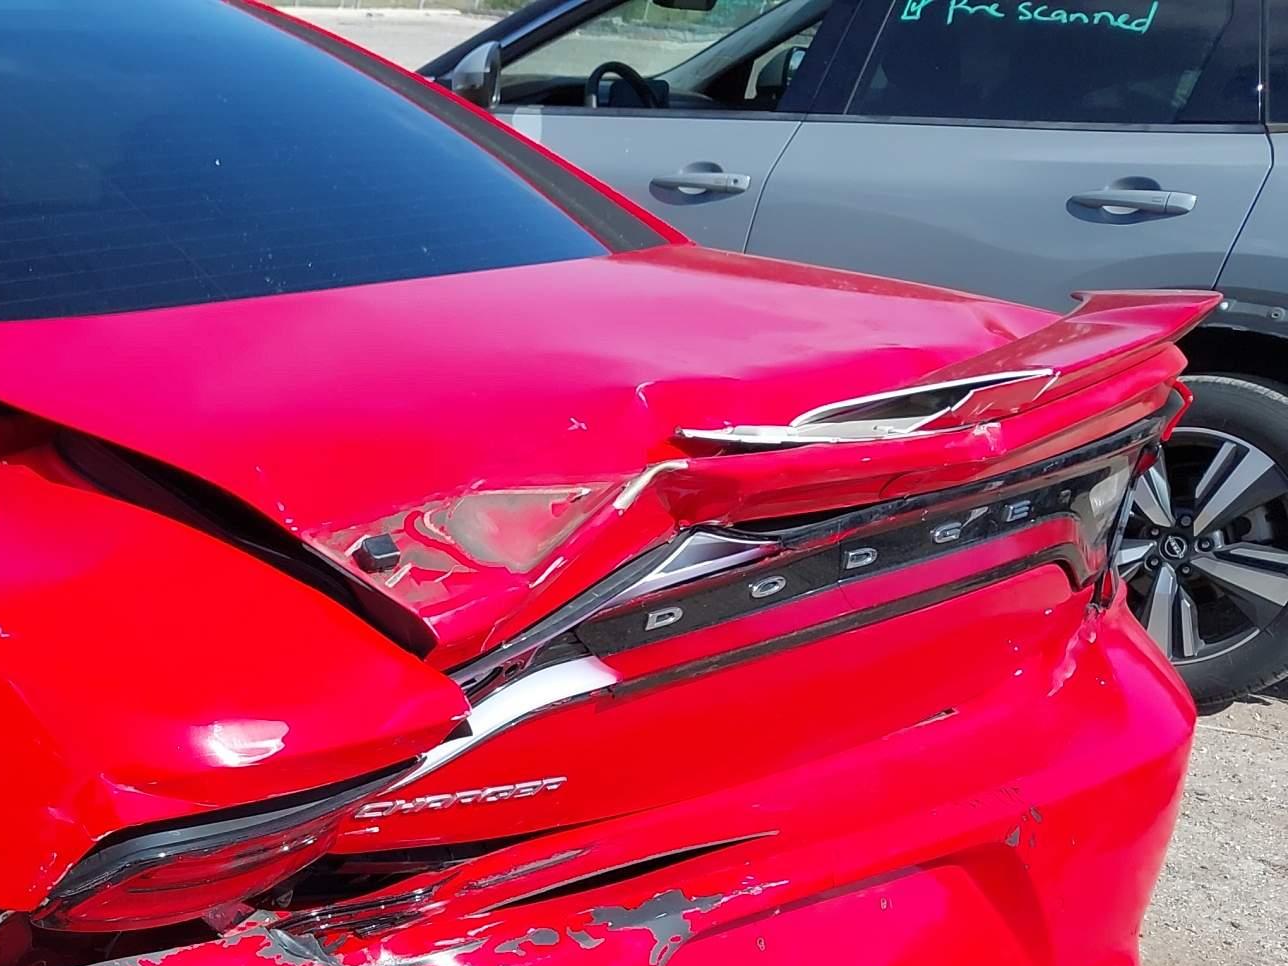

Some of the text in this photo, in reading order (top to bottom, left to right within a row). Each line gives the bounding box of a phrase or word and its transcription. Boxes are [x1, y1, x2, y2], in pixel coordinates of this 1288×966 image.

[1018, 1, 1159, 34] scanned
[644, 500, 1034, 632] DODGE
[354, 775, 568, 819] CHARGER
